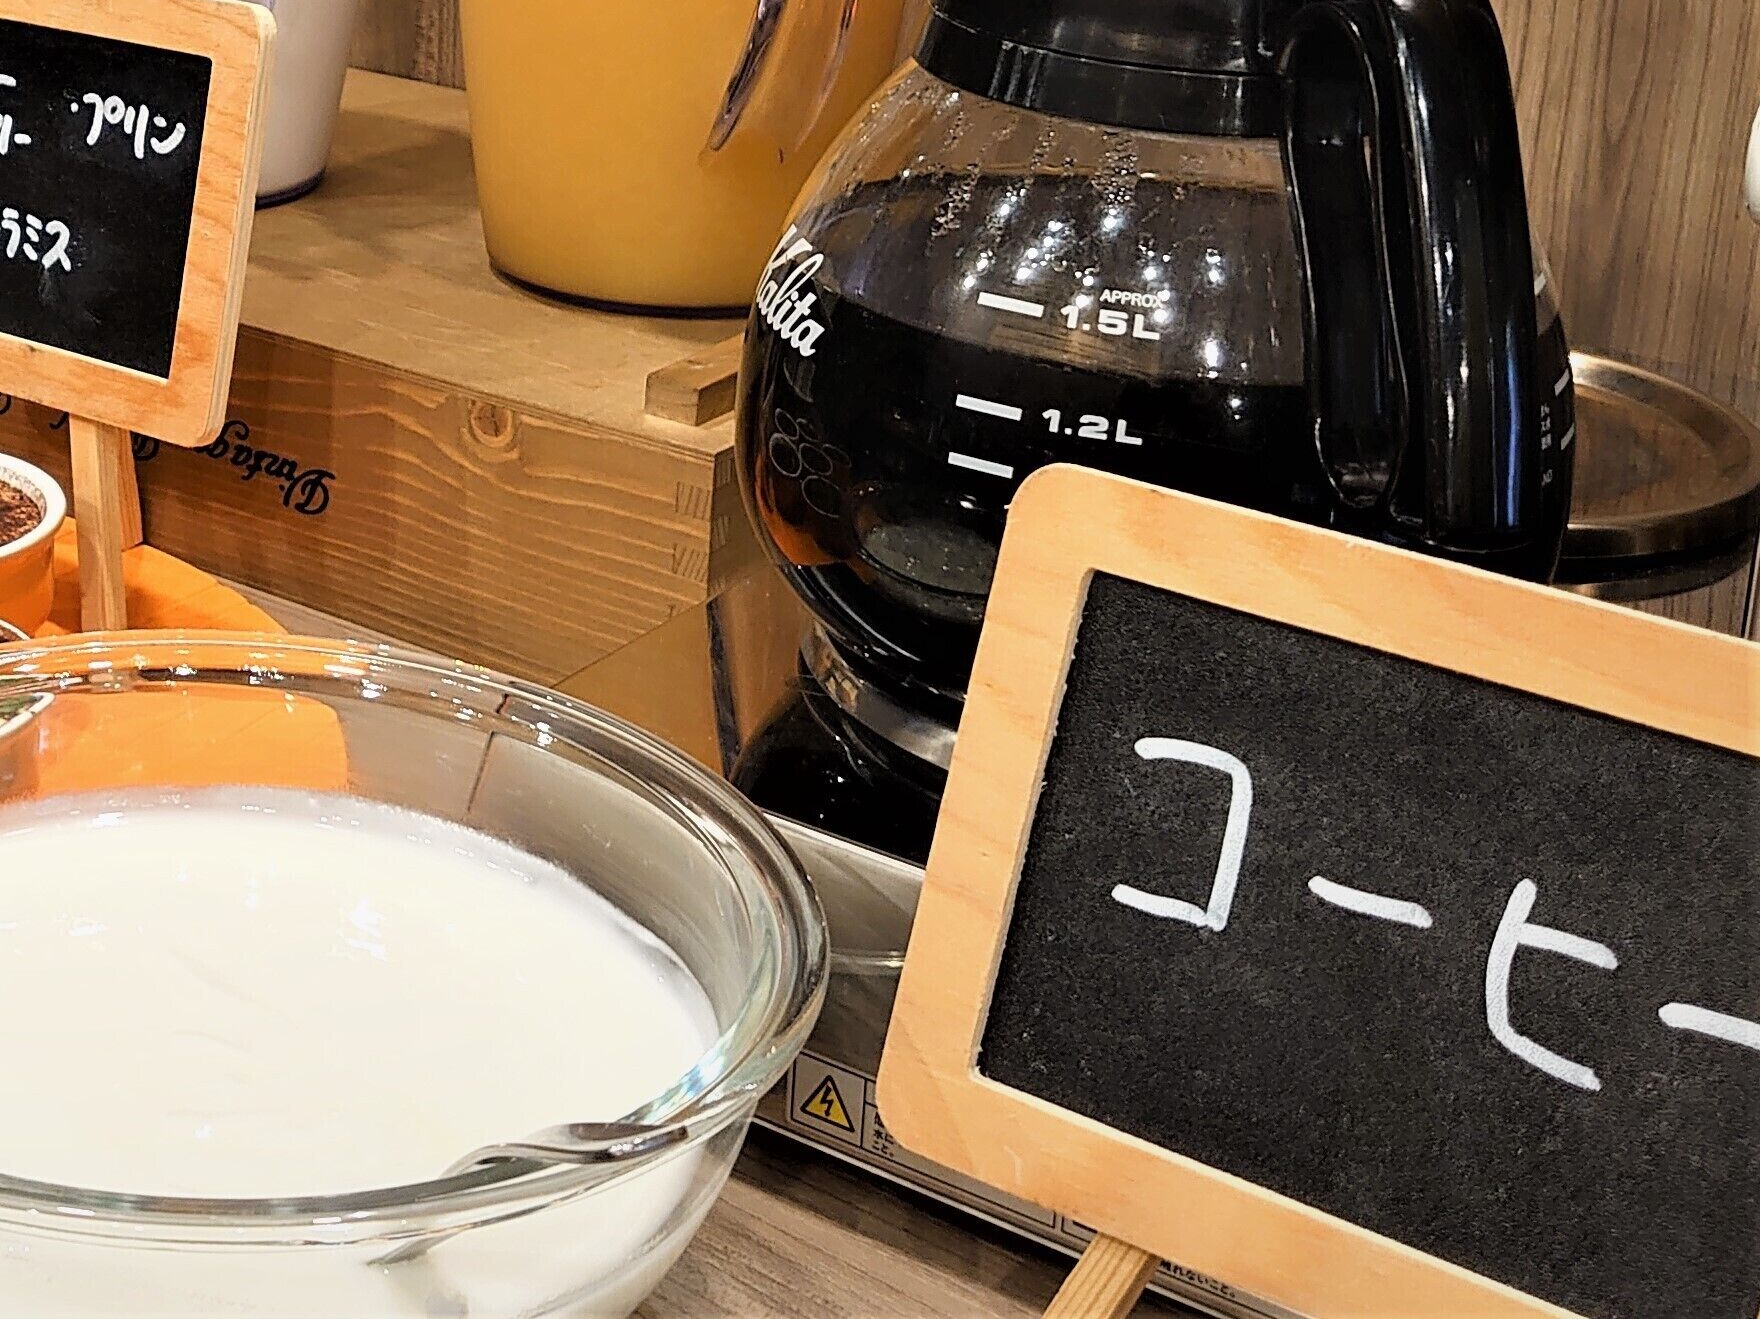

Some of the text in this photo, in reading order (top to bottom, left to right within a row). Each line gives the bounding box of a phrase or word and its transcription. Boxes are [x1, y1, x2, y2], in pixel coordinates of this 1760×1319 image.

[755, 223, 826, 357] Kalita
[1042, 408, 1143, 446] 1.2L
[1110, 736, 1760, 1092] コーヒー
